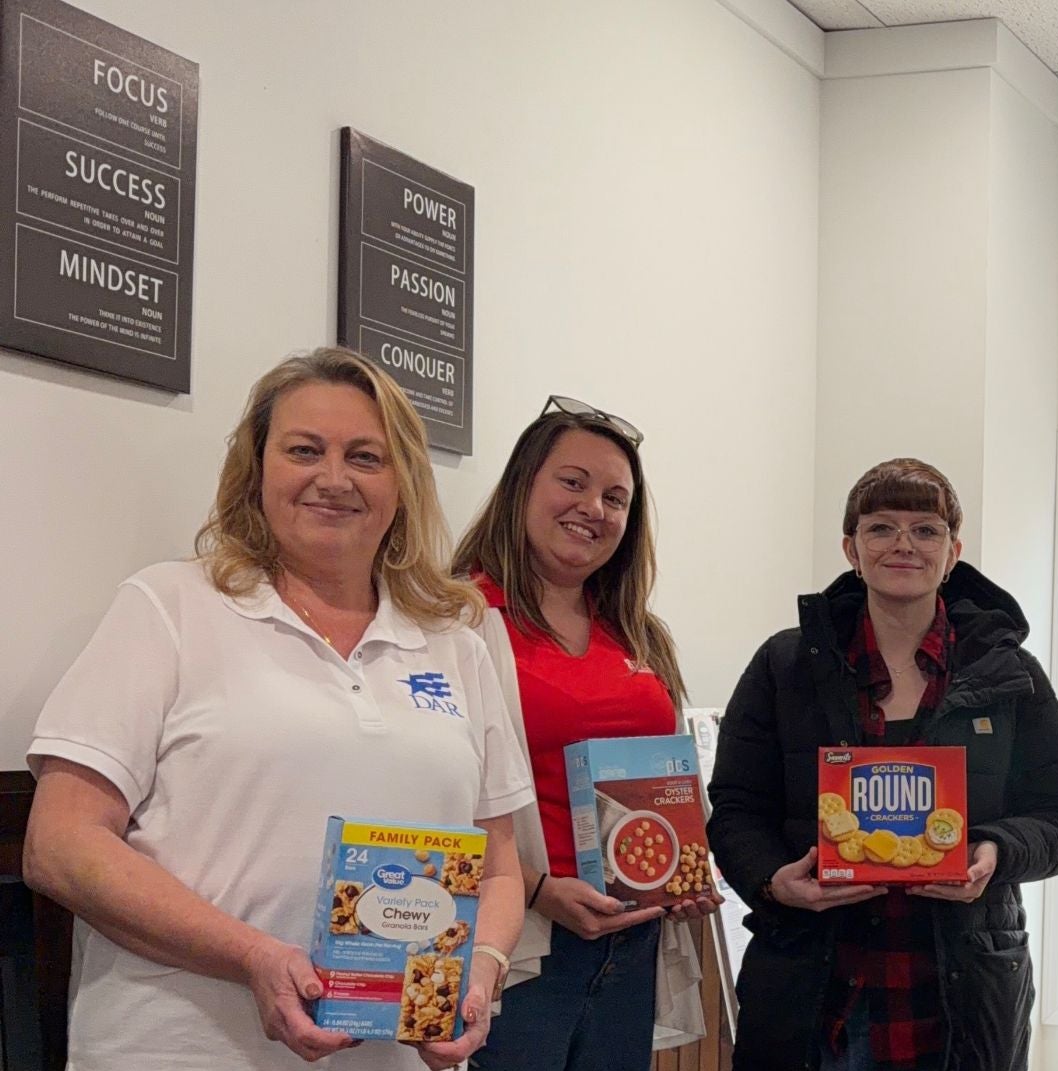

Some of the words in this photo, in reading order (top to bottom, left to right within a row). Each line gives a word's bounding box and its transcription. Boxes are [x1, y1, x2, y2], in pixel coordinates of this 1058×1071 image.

[93, 58, 168, 114] FOCUS
[95, 107, 118, 122] FOLLOW
[150, 114, 167, 129] VERB
[65, 150, 166, 209] SUCCESS
[41, 189, 68, 204] PERFORM
[70, 199, 100, 216] REPETITIVE
[120, 216, 135, 228] OVER
[136, 223, 149, 232] AND
[150, 227, 164, 237] OVER
[403, 187, 457, 230] POWER
[144, 210, 165, 225] NOUN
[83, 216, 90, 225] IN
[92, 219, 110, 231] ORDER
[112, 225, 120, 235] TO
[122, 230, 142, 242] ATTAIN
[143, 236, 148, 244] A
[149, 238, 164, 249] GOAL
[59, 249, 164, 304] MINDSET
[391, 264, 456, 308] PASSION
[141, 307, 163, 320] NOUN
[68, 312, 79, 322] THE
[80, 316, 100, 328] POWER
[108, 324, 119, 333] THE
[119, 327, 134, 337] MIND
[380, 342, 455, 385] CONQUER
[409, 694, 465, 718] DAR
[871, 765, 914, 774] GOLDEN
[664, 786, 694, 797] OYSTER
[853, 775, 932, 812] ROUND
[653, 795, 695, 806] CRACKERS
[870, 814, 914, 822] CRACKERS
[369, 830, 419, 845] FAMILY
[424, 835, 462, 849] PACK
[345, 847, 369, 864] 24
[377, 868, 405, 881] Great
[383, 878, 405, 886] Value
[376, 895, 412, 908] Variety
[414, 898, 440, 909] Pack
[382, 907, 431, 924] Chewy
[381, 921, 412, 930] Granola
[413, 923, 429, 931] Bars
[329, 970, 336, 979] 9
[328, 980, 334, 988] 9
